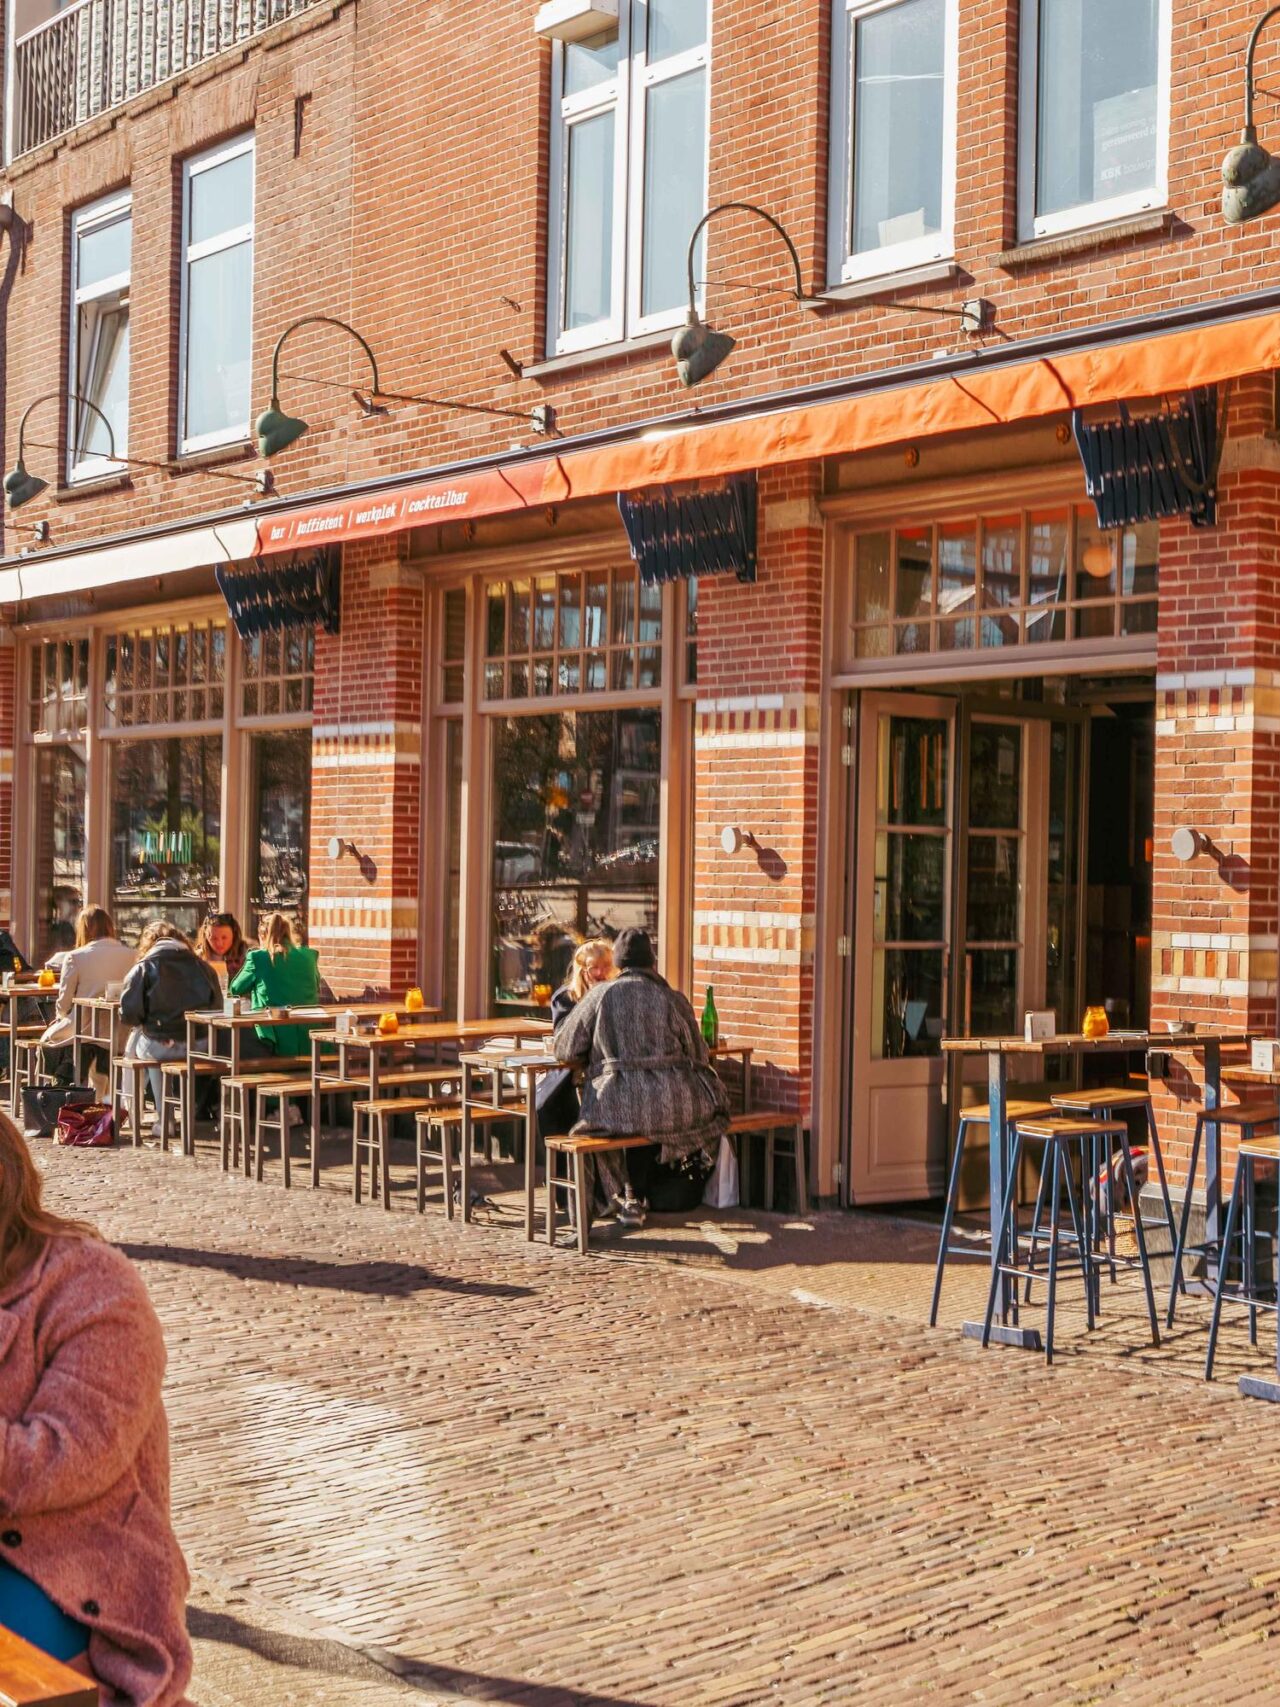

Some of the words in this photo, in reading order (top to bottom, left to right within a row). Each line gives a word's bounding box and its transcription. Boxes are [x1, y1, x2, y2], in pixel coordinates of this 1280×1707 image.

[270, 526, 286, 540] bar
[296, 514, 344, 535] koffietent
[355, 502, 397, 525] werkplek
[408, 490, 469, 513] cocktailbar
